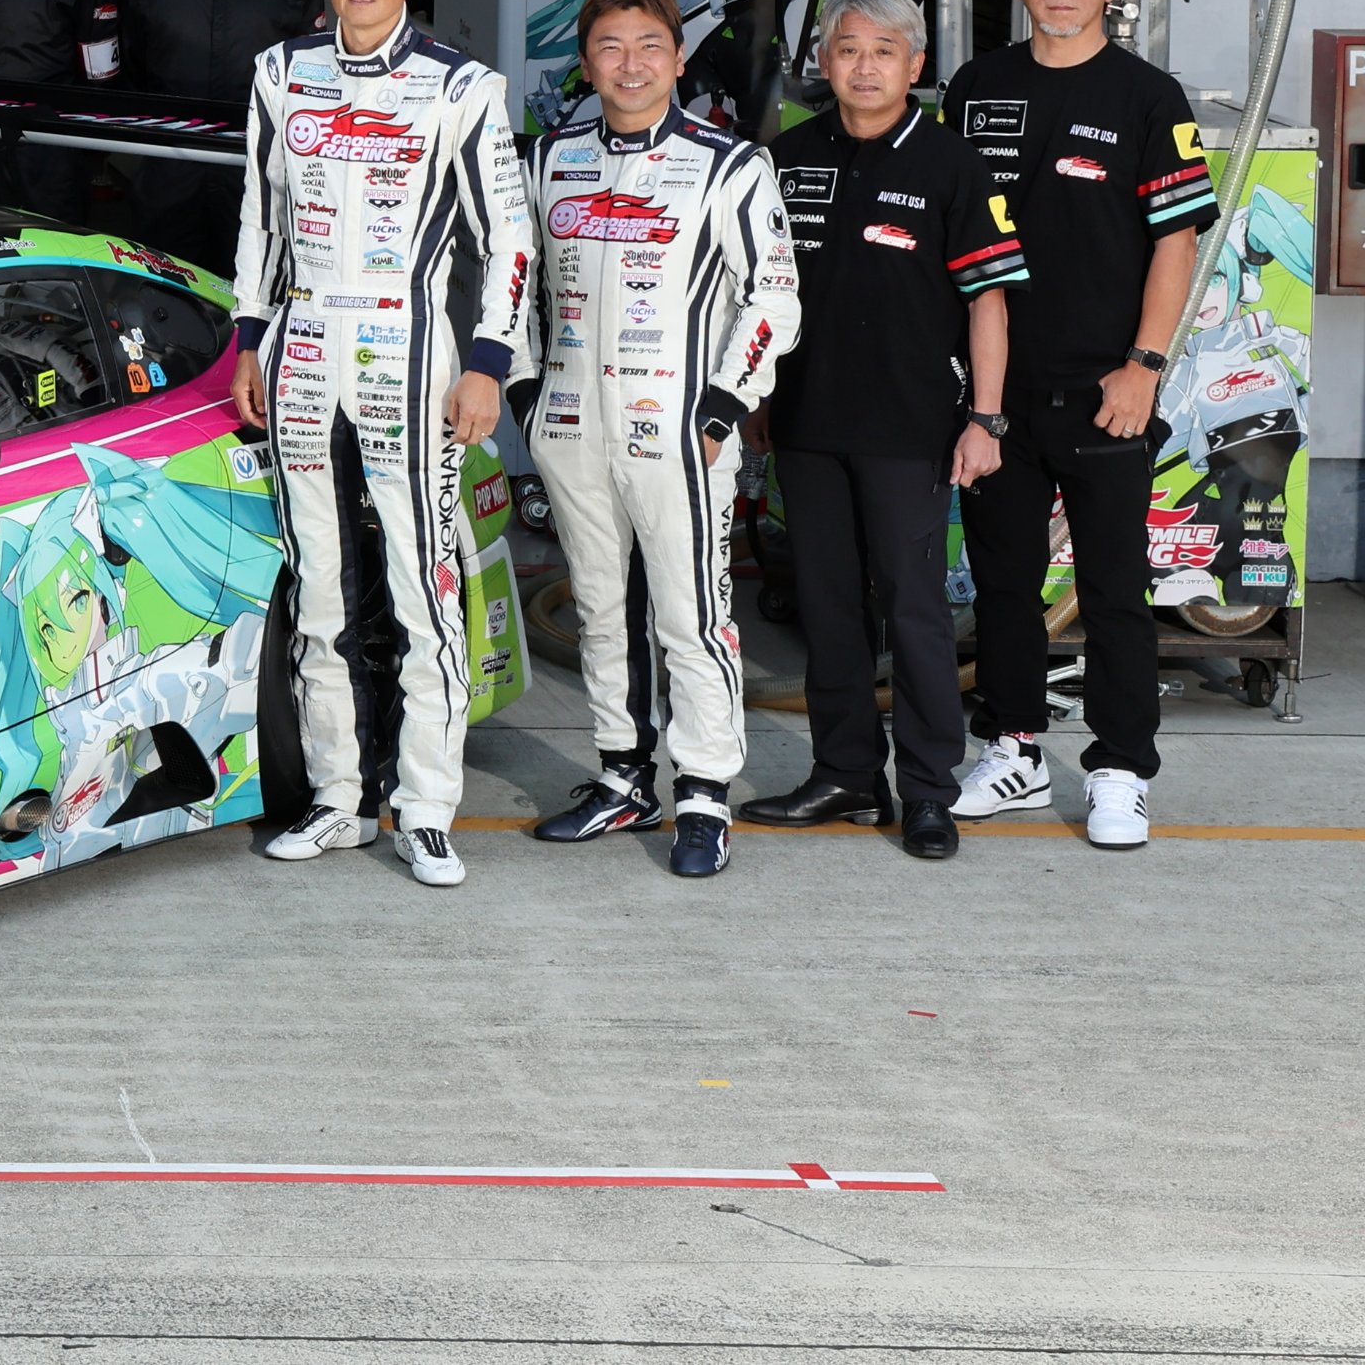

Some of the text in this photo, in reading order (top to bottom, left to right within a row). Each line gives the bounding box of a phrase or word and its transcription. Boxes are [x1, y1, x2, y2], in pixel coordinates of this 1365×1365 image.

[302, 87, 341, 99] YOKOHAMA
[559, 121, 597, 134] YOKOHAMA
[696, 128, 733, 146] YOKOHAMA
[1070, 123, 1117, 144] AVIREX USA
[331, 134, 424, 149] GOODSMILE
[319, 145, 399, 162] RACING
[302, 170, 326, 178] SOCIAL
[370, 168, 406, 179] SOKUDO
[563, 172, 599, 181] YOKOHAMA
[300, 179, 326, 188] SOCIAL
[364, 191, 407, 199] BANPRESTO
[877, 190, 925, 210] AVIREX USA
[588, 217, 677, 230] GOODSMILE
[788, 214, 825, 224] OKOHAMA
[298, 221, 329, 235] POP MART
[367, 225, 402, 234] FUCHS
[578, 226, 651, 241] RACING
[562, 246, 577, 254] ANTI
[372, 257, 394, 265] KIMIE
[559, 254, 580, 264] SOCIAL
[559, 264, 580, 273] SOCIAL
[626, 307, 657, 316] FUCHS
[290, 318, 324, 336] HKS
[289, 345, 320, 360] TONE
[291, 371, 326, 382] MODELS
[619, 367, 648, 376] TATSUYA
[130, 370, 144, 386] 10
[357, 371, 374, 384] Eco
[291, 388, 326, 398] FUJIMAKI
[1228, 383, 1265, 398] RACING
[370, 405, 402, 414] ACRE
[359, 412, 402, 421] BRAKES
[360, 438, 402, 451] CRS
[287, 463, 325, 472] KYB
[475, 490, 490, 510] POP
[1240, 539, 1290, 560] 初音ミク
[1243, 573, 1286, 582] MIKU
